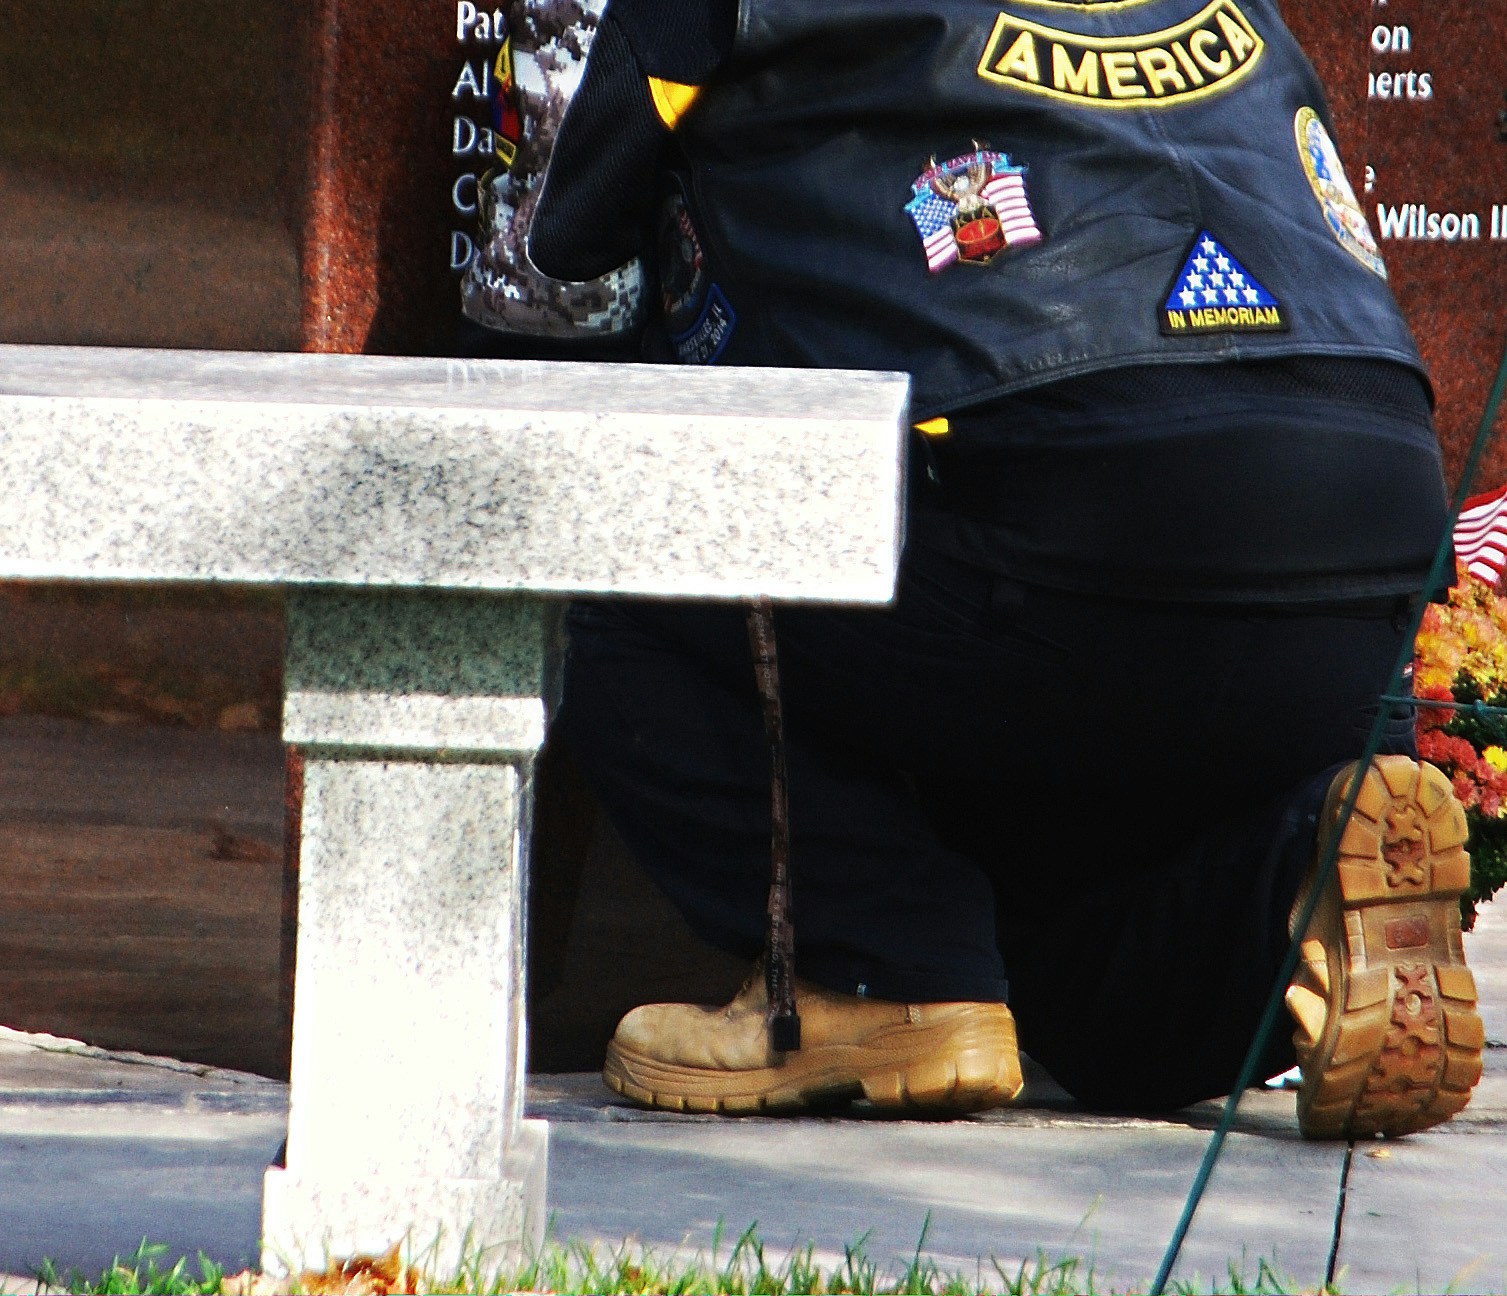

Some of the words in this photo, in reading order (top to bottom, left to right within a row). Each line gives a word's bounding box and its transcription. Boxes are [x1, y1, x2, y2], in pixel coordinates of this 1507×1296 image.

[995, 9, 1255, 98] AMERICA
[1377, 203, 1479, 239] Wilson
[1167, 309, 1186, 328] IN
[1189, 306, 1280, 327] MEMORIAM
